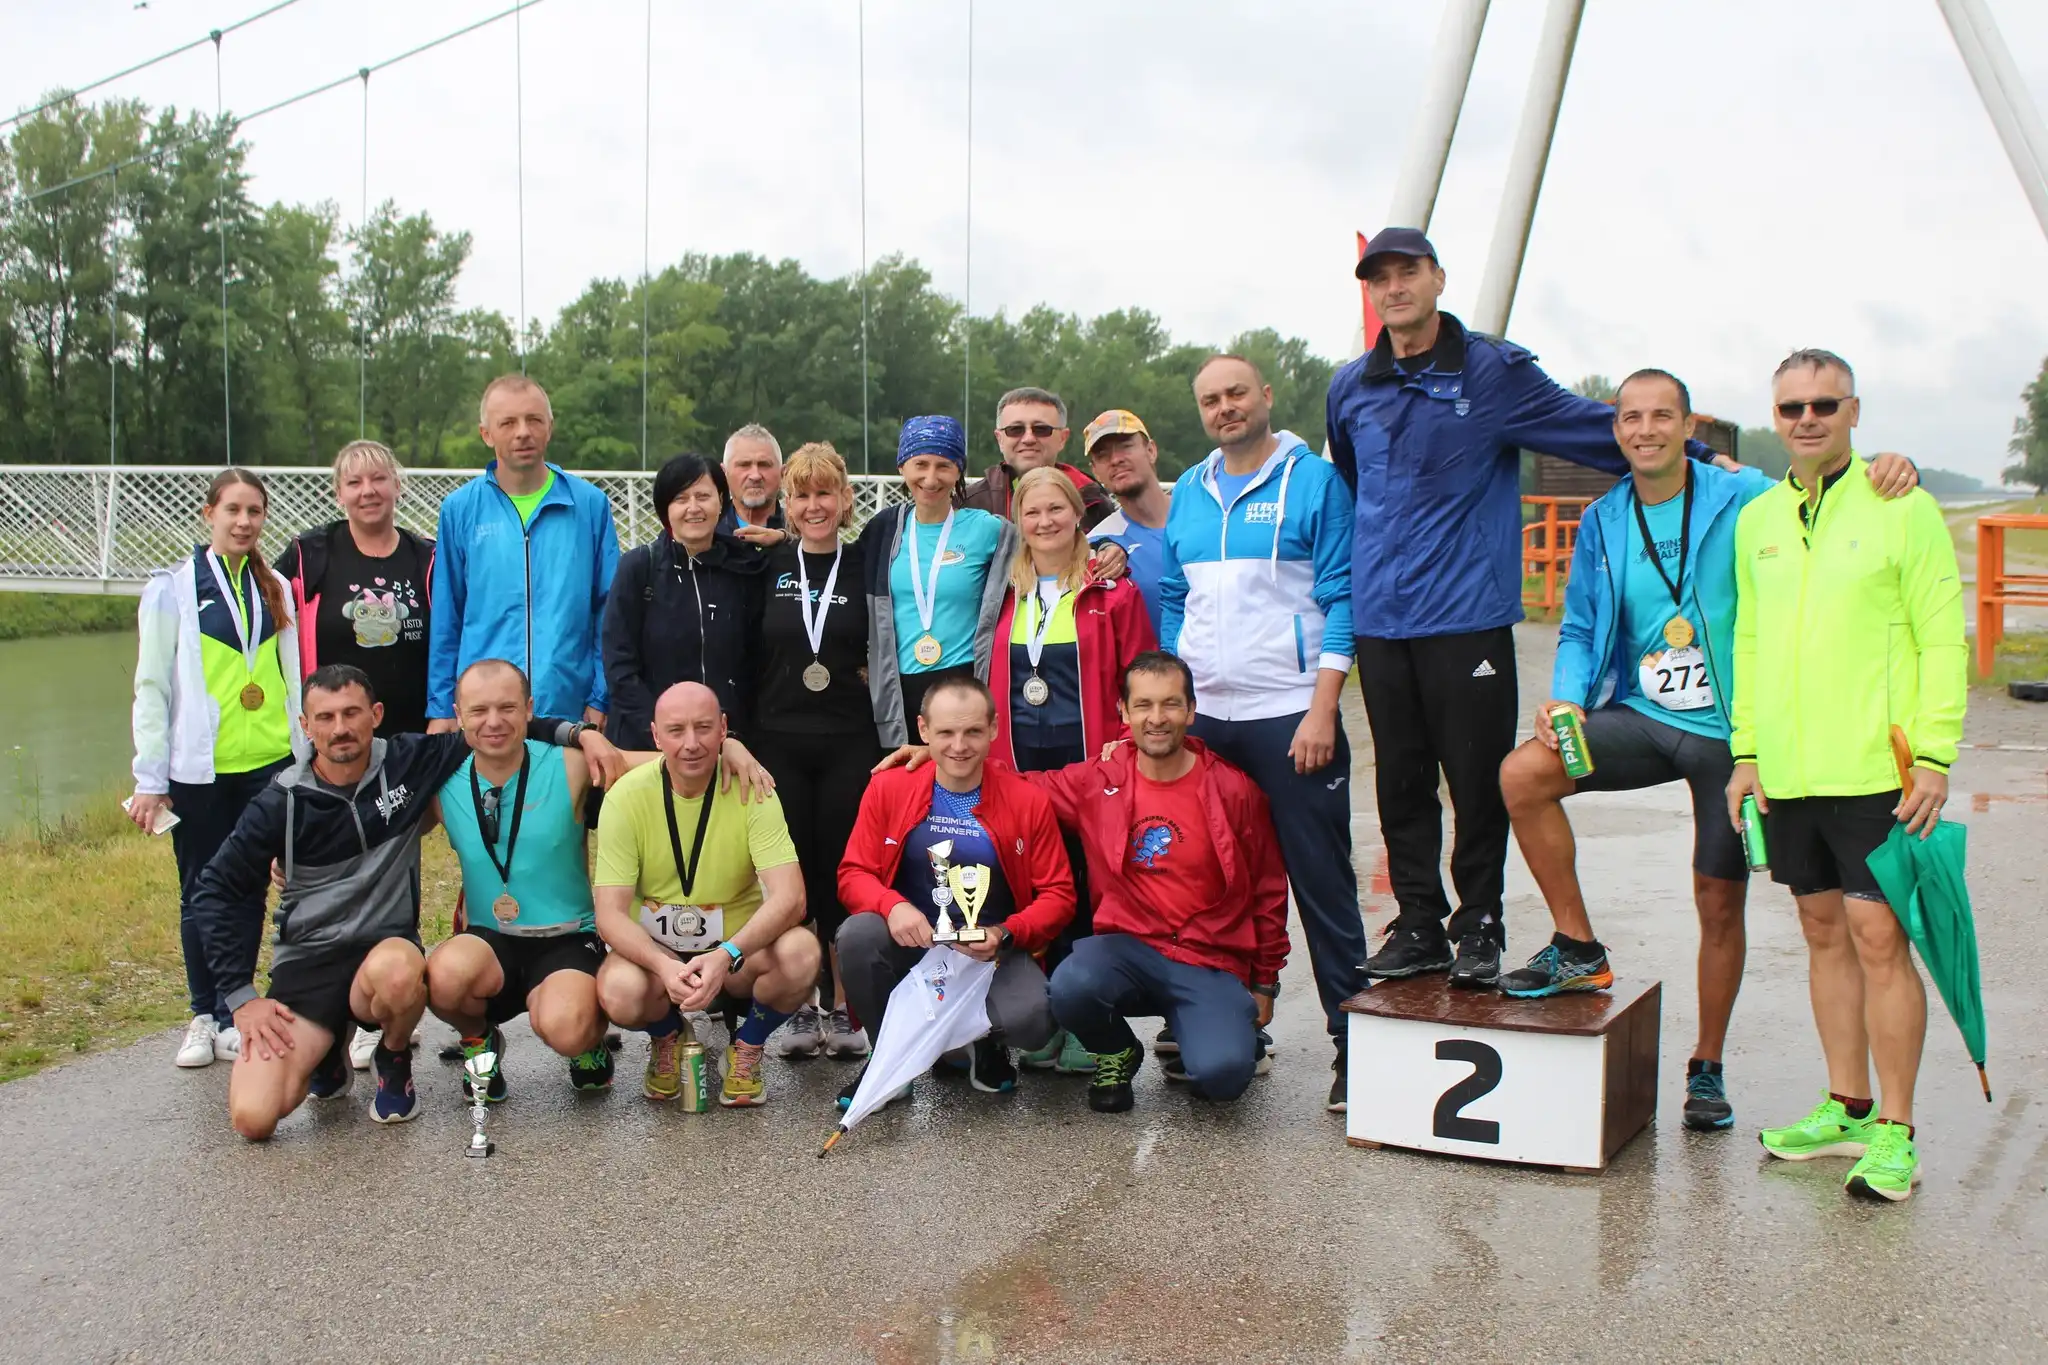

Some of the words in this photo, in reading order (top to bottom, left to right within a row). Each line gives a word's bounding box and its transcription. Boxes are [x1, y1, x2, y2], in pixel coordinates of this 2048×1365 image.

[1656, 662, 1709, 694] 272
[1556, 728, 1579, 765] PAN
[930, 824, 980, 838] RUNNERS
[699, 1063, 708, 1100] PAN
[1433, 1039, 1503, 1145] 2
